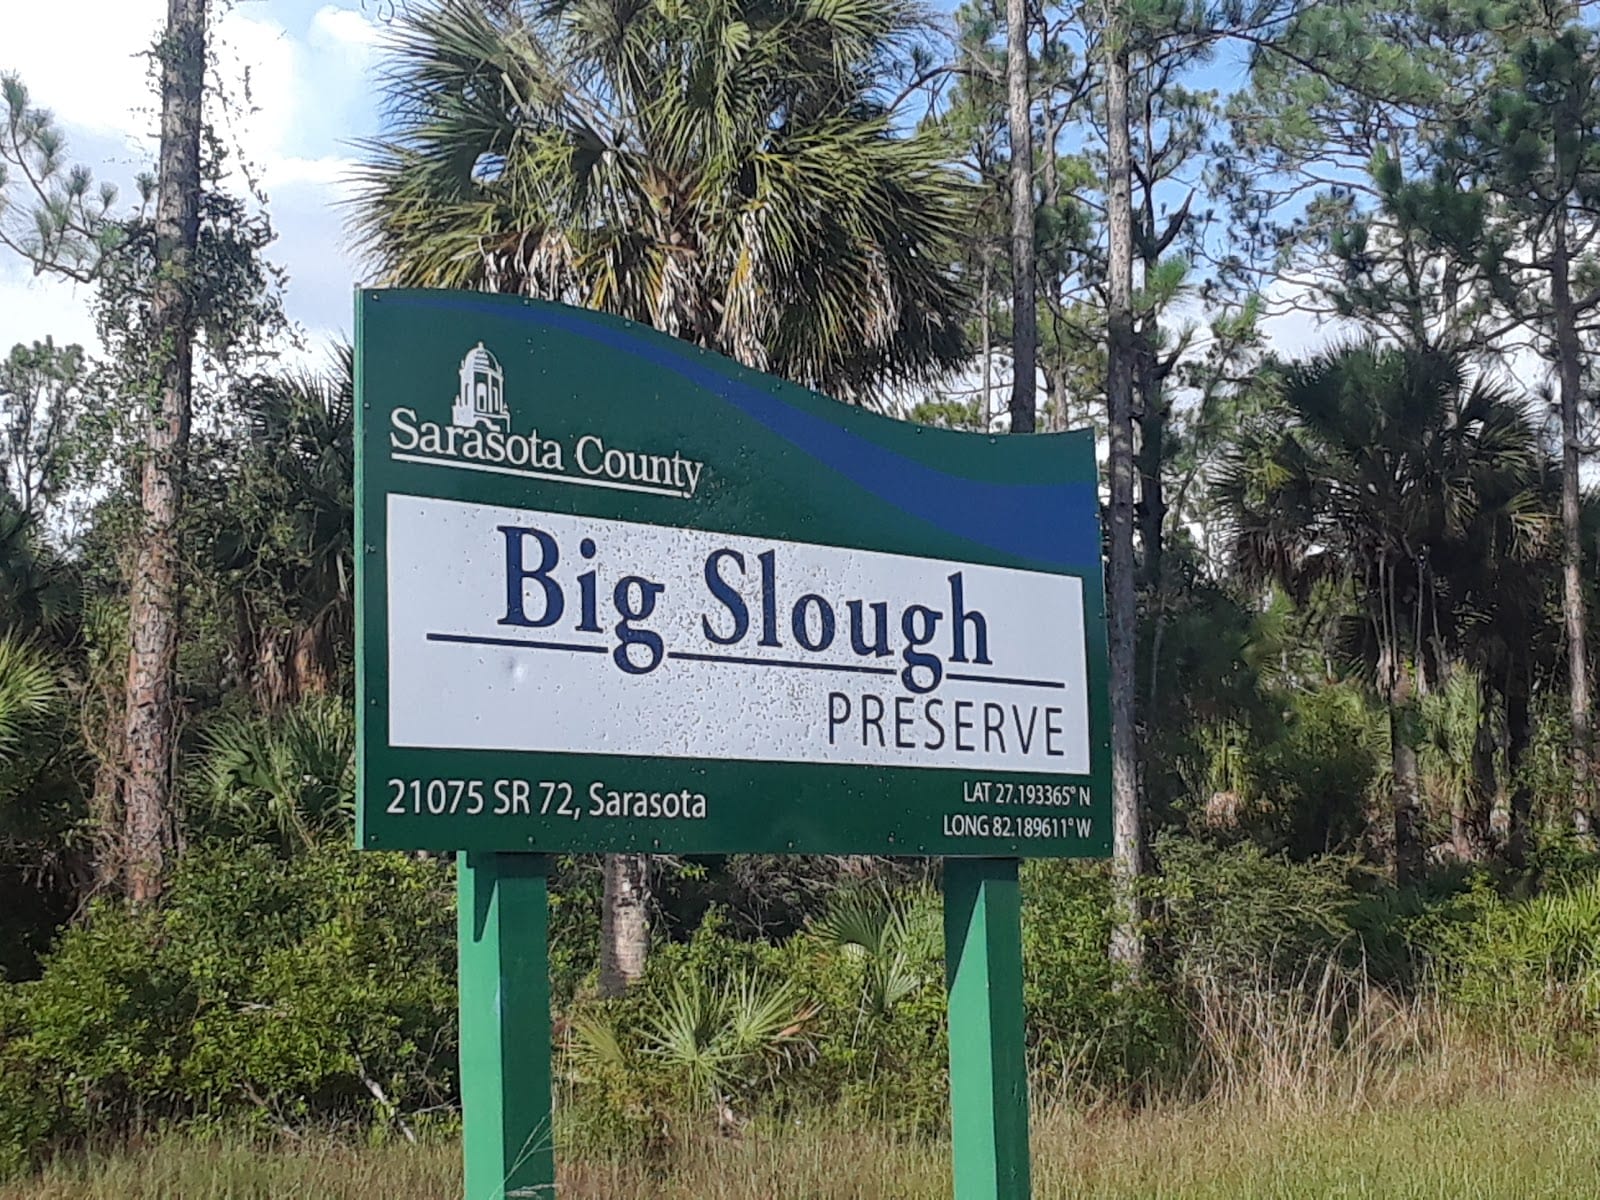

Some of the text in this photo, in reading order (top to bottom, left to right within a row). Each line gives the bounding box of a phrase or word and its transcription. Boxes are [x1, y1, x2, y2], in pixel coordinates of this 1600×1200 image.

[390, 406, 704, 499] Sarasota County
[497, 525, 993, 694] Big Slough
[828, 692, 1065, 757] PRESERVE
[386, 779, 707, 820] 21075 SR 72, Sarasota
[964, 781, 993, 803] LAT
[1079, 787, 1091, 807] N
[943, 815, 989, 836] LONG
[1076, 818, 1091, 838] W
